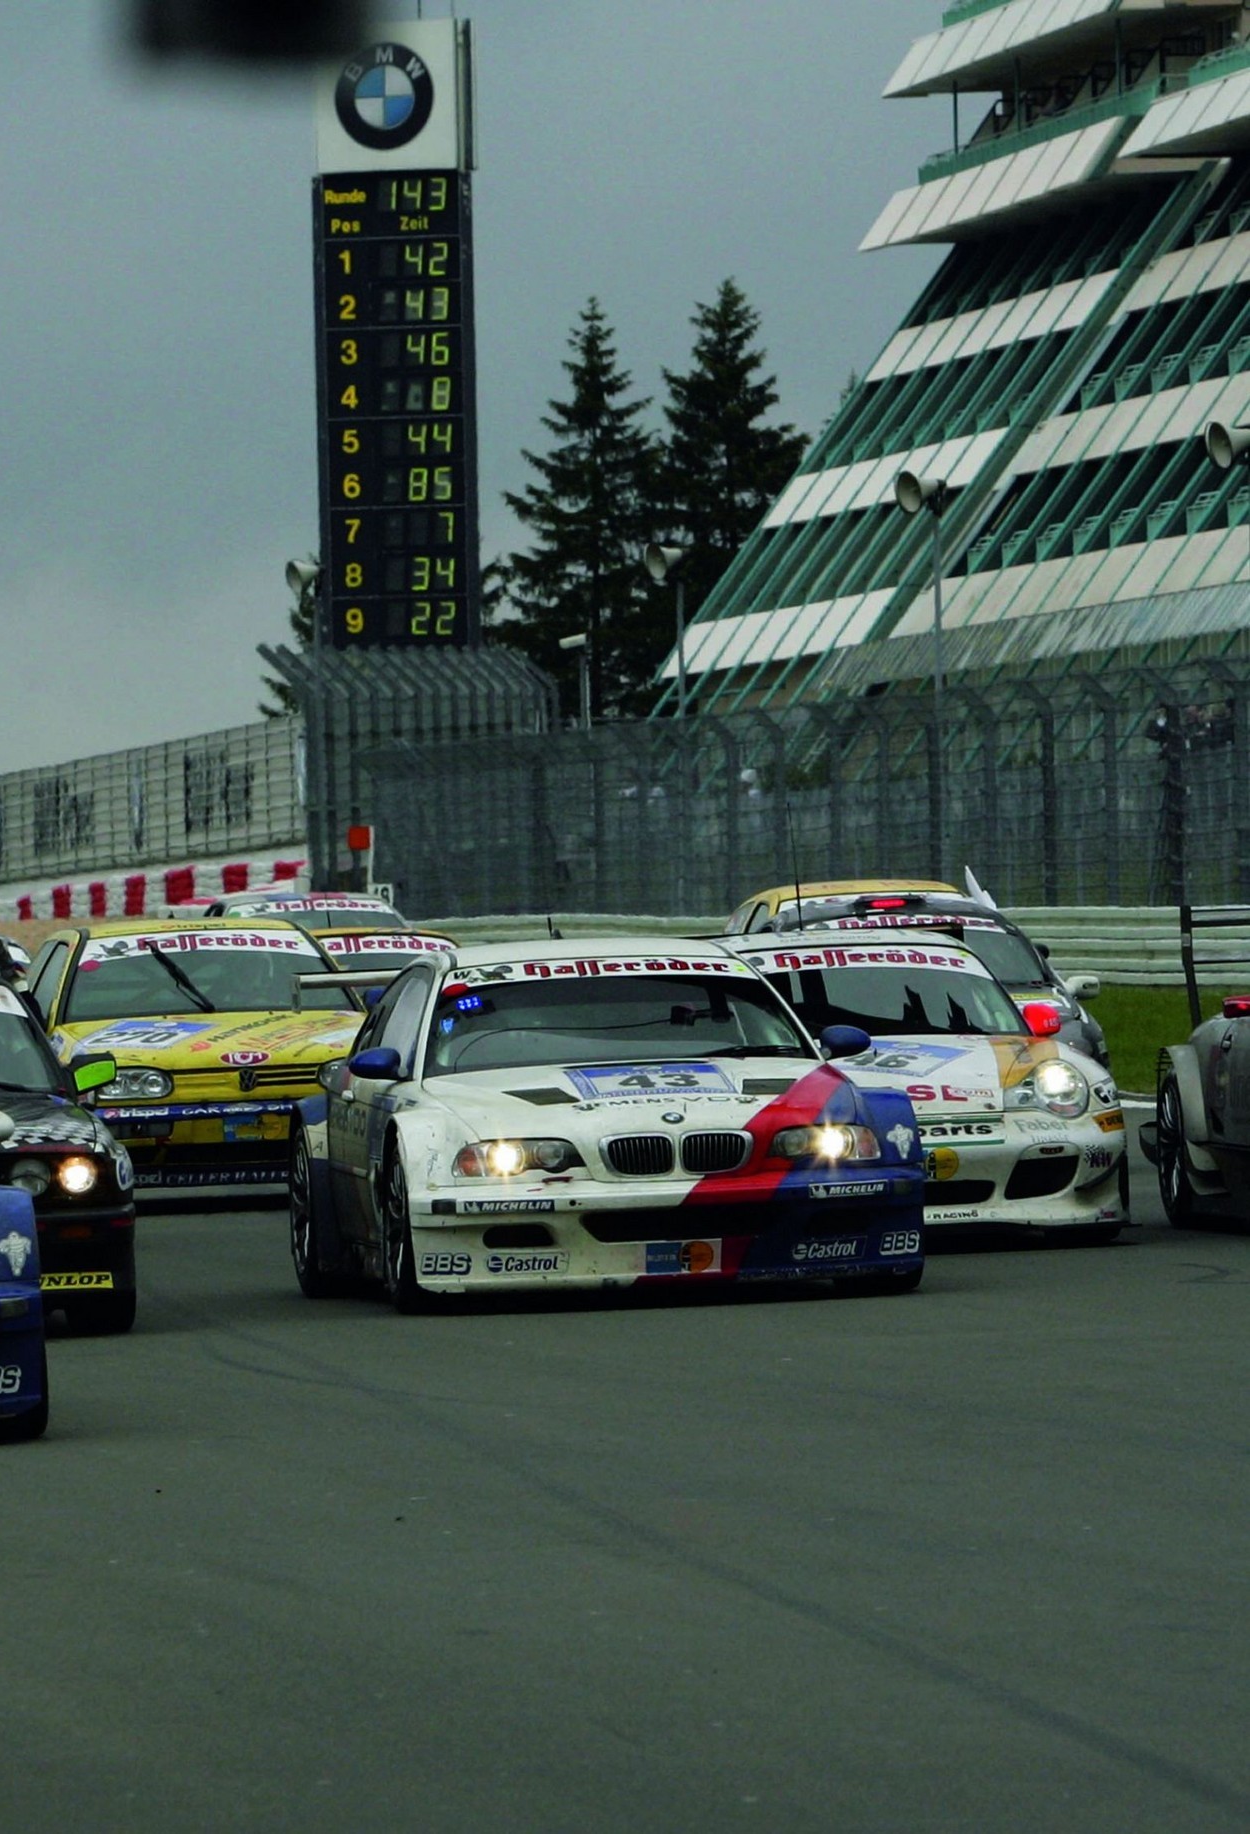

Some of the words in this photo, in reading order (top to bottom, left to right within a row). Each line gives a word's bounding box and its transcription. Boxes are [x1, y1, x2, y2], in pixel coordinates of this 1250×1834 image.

[324, 188, 367, 206] Runde
[390, 177, 448, 211] 143
[330, 217, 361, 234] Pos
[400, 216, 429, 231] Zeit
[338, 250, 352, 275] 1
[405, 242, 448, 276] 42
[339, 295, 357, 320] 2
[405, 287, 449, 321] 43
[340, 339, 358, 365] 3
[407, 331, 450, 366] 46
[340, 384, 359, 410] 4
[341, 429, 360, 454] 5
[408, 423, 452, 454] 44
[342, 473, 361, 498] 6
[408, 467, 452, 501] 85
[344, 518, 361, 543] 7
[438, 512, 454, 543] 7
[344, 562, 363, 588] 8
[411, 557, 455, 591] 34
[345, 608, 364, 633] 9
[411, 601, 456, 635] 22
[320, 932, 451, 954] asseröder
[93, 1029, 178, 1045] 270
[844, 1052, 918, 1069] 46
[618, 1073, 701, 1089] 43
[829, 1183, 884, 1194] MICHELIN
[481, 1200, 552, 1211] MICHELIN
[807, 1240, 857, 1259] Castrol
[879, 1230, 920, 1256] BBS
[421, 1252, 472, 1276] BBS
[504, 1253, 559, 1273] Castrol
